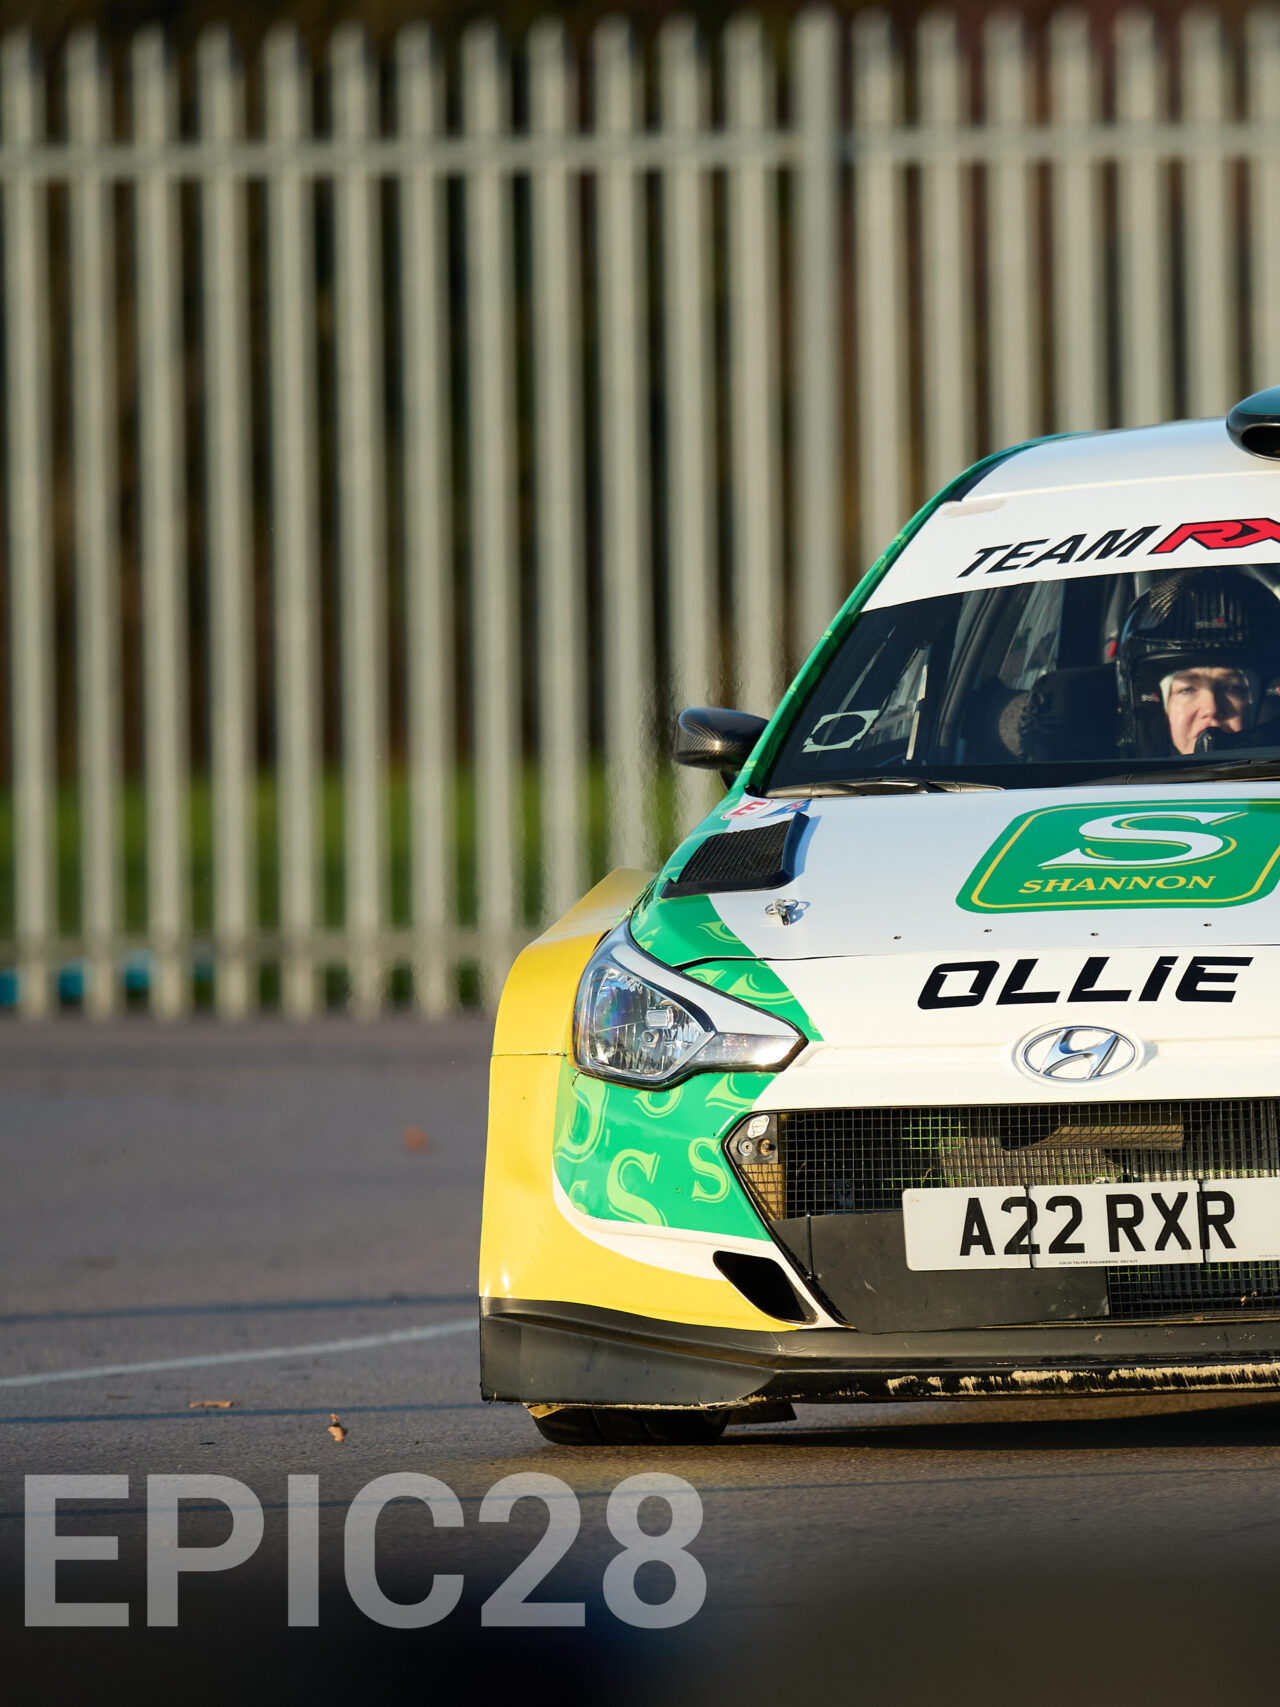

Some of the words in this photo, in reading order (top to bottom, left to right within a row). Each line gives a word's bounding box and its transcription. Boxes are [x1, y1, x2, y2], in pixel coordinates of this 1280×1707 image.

[956, 525, 1162, 578] TEAM
[1018, 876, 1217, 894] SHANNON
[917, 956, 1255, 1010] OLLIE
[959, 1195, 1086, 1257] A22
[1105, 1190, 1238, 1254] RXR
